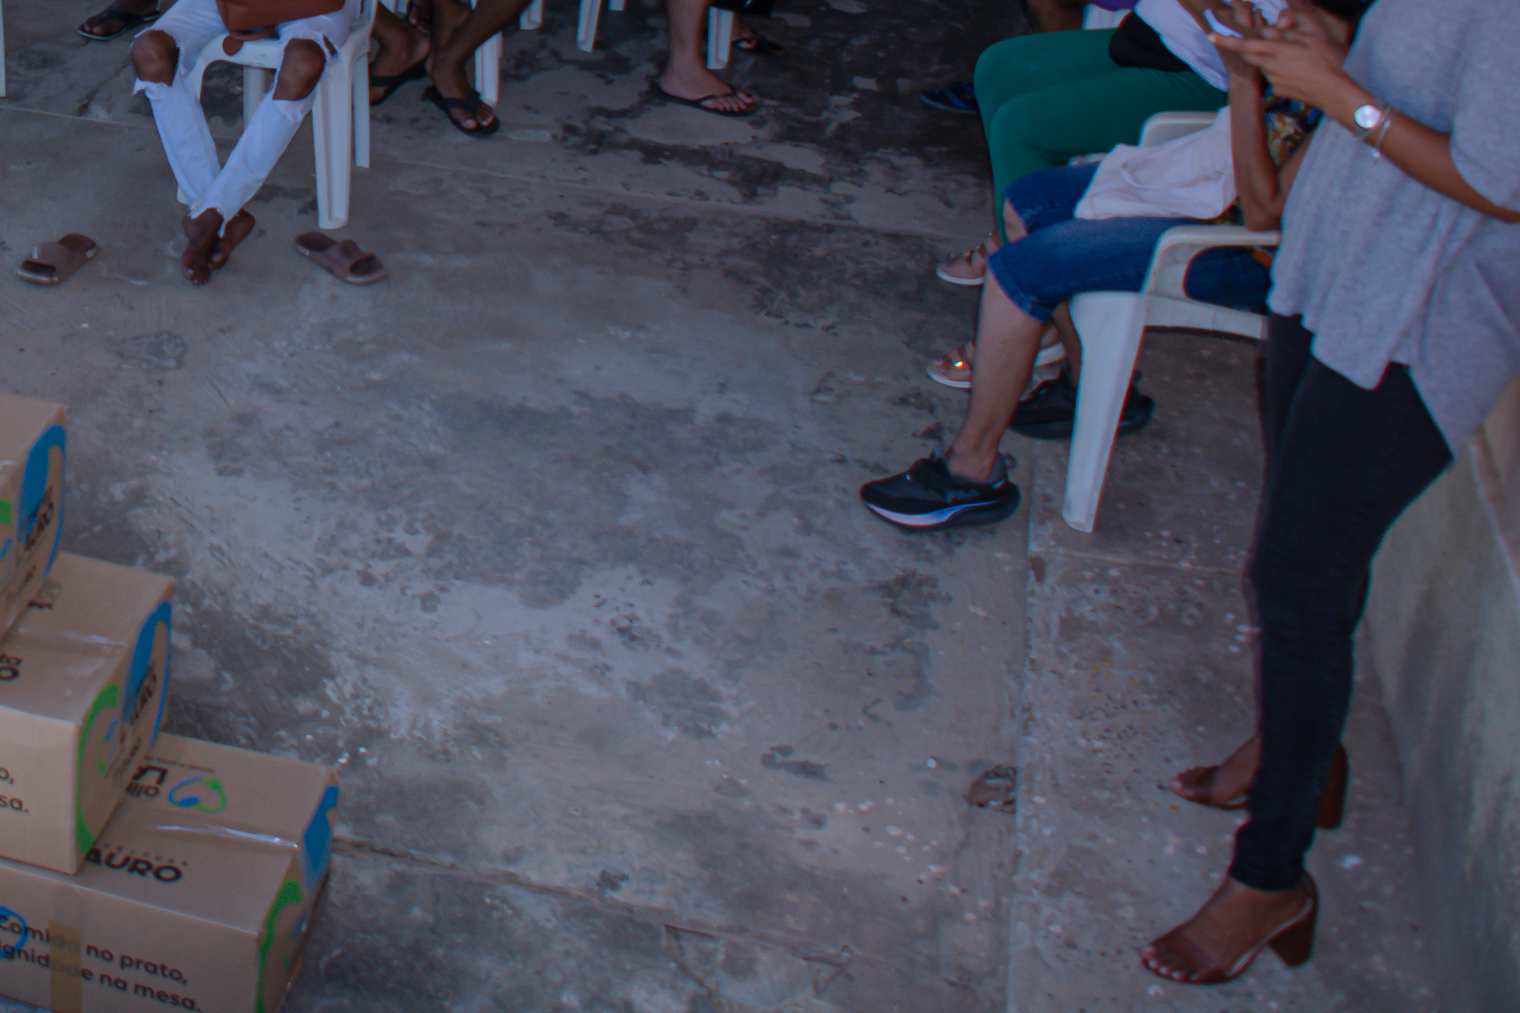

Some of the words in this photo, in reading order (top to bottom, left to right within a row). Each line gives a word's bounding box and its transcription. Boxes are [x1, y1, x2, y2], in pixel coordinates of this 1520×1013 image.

[84, 847, 182, 882] AURO
[86, 945, 114, 962] no
[119, 954, 188, 987] prato,
[98, 973, 128, 992] na
[133, 983, 202, 1013] mesa.
